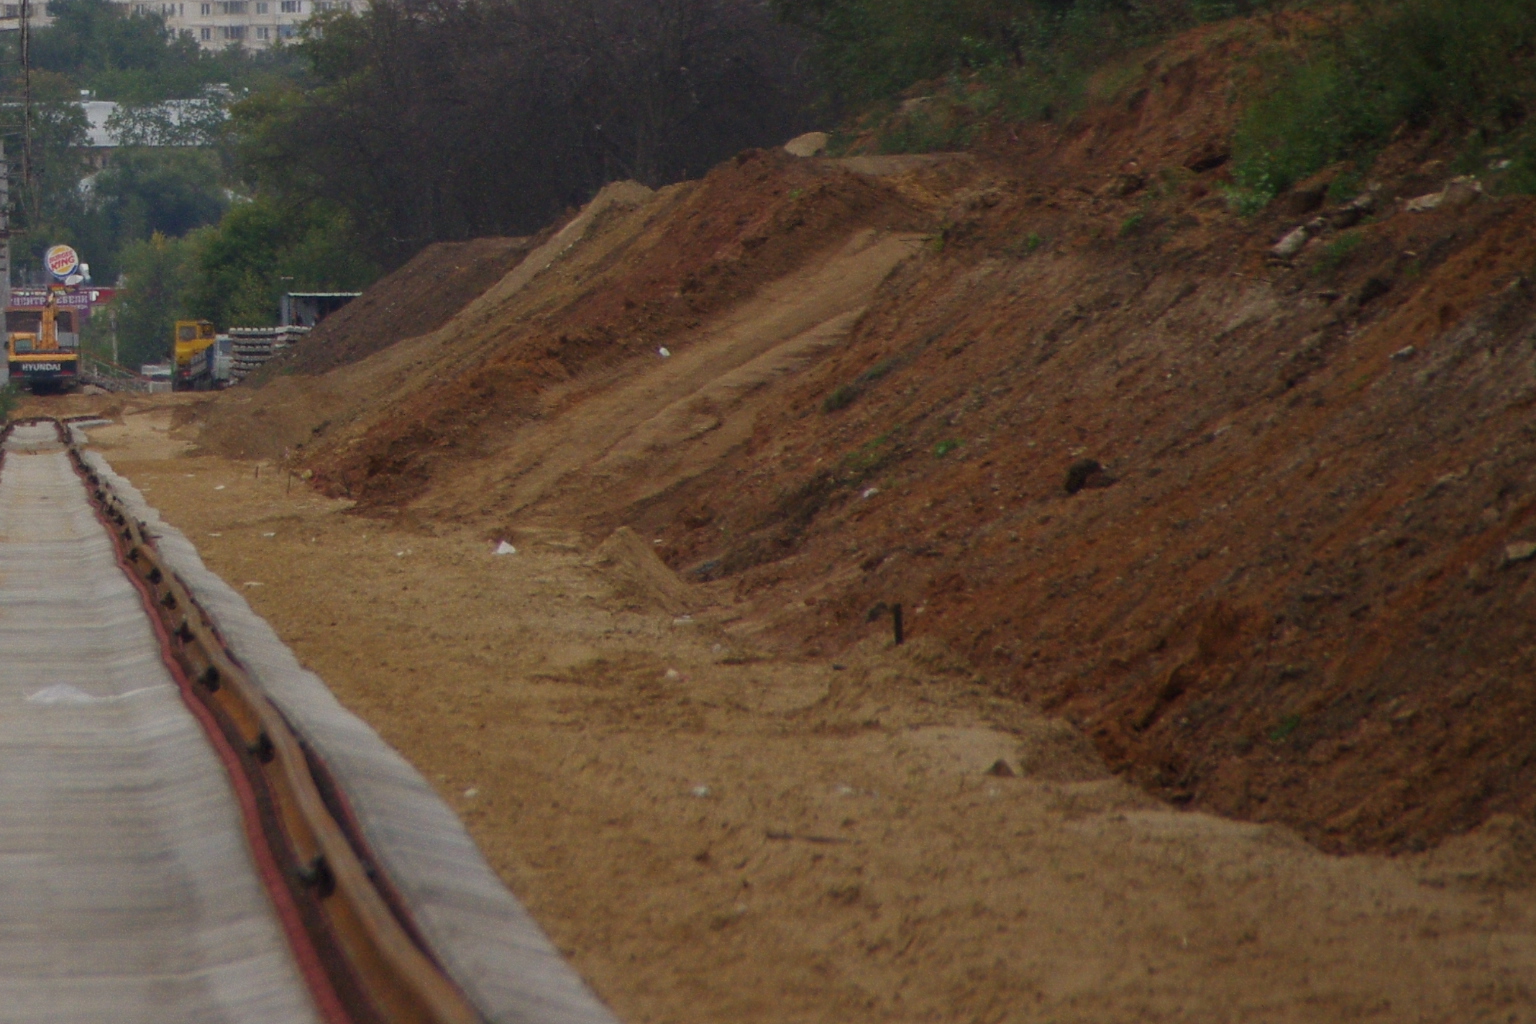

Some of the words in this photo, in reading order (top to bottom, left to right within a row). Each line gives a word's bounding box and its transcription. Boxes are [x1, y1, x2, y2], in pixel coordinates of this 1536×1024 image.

[49, 249, 73, 264] BURGER
[51, 255, 76, 271] KING
[22, 363, 61, 371] HYUNDAI
